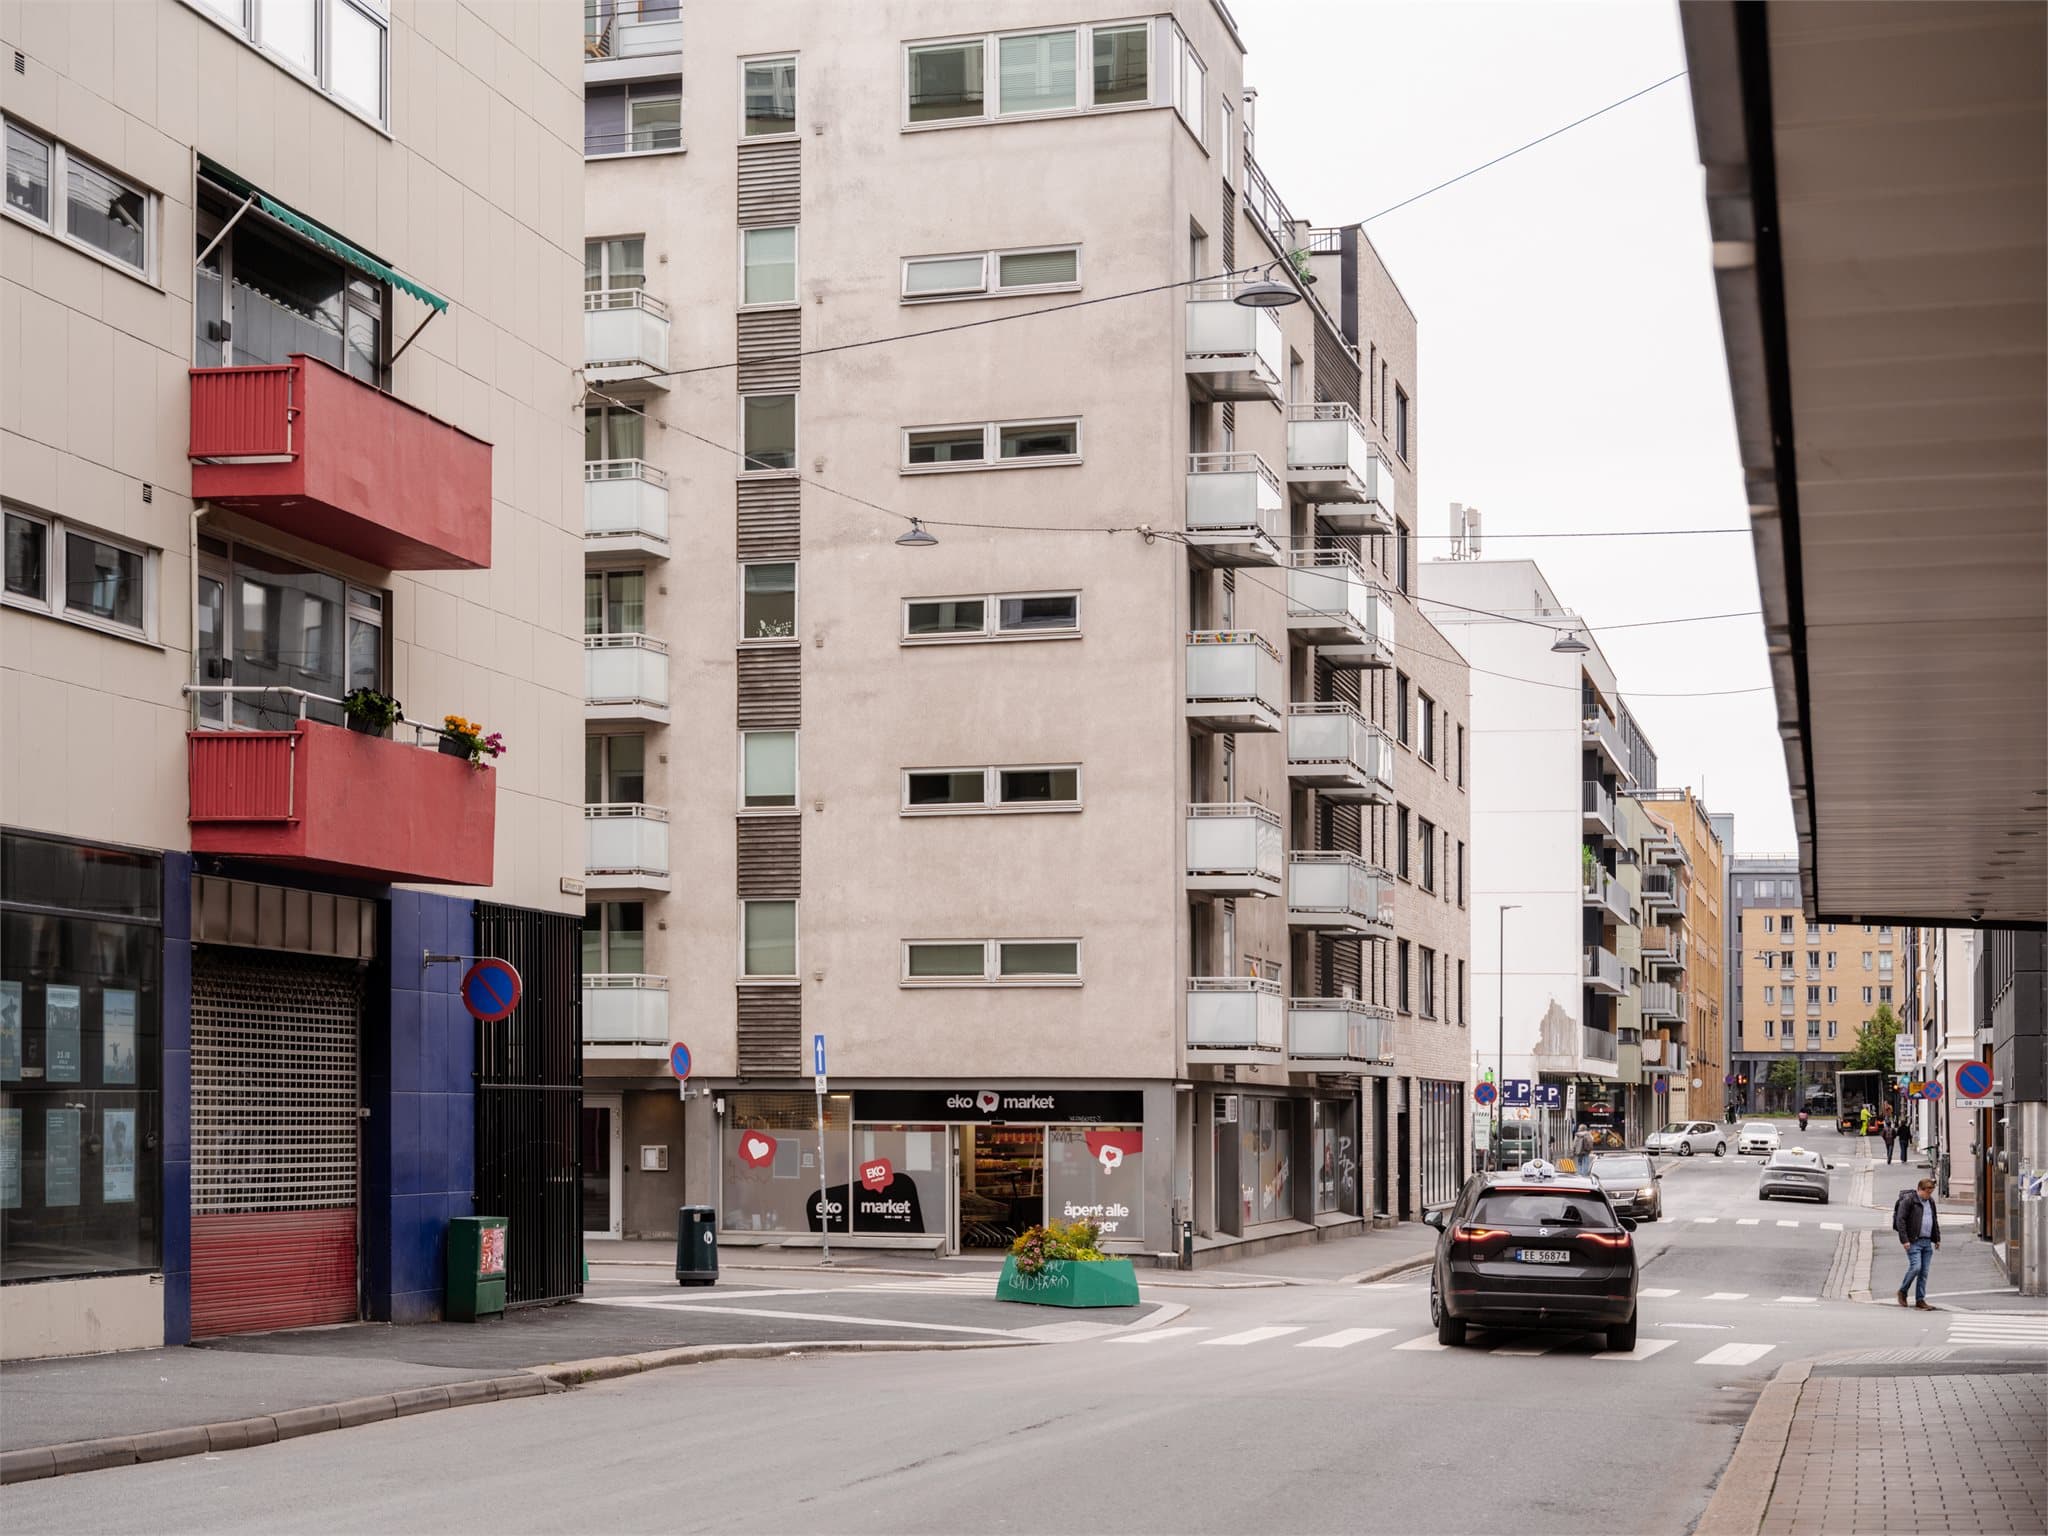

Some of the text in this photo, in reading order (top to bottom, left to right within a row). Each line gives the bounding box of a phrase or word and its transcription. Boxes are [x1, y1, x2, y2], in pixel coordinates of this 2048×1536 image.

[1517, 1083, 1529, 1098] P
[1548, 1087, 1558, 1101] P
[946, 1093, 1055, 1109] eko market
[865, 1165, 886, 1180] EKO
[815, 1199, 911, 1214] eko market
[1063, 1200, 1129, 1219] åpent alle
[1524, 1250, 1567, 1261] EE 56874
